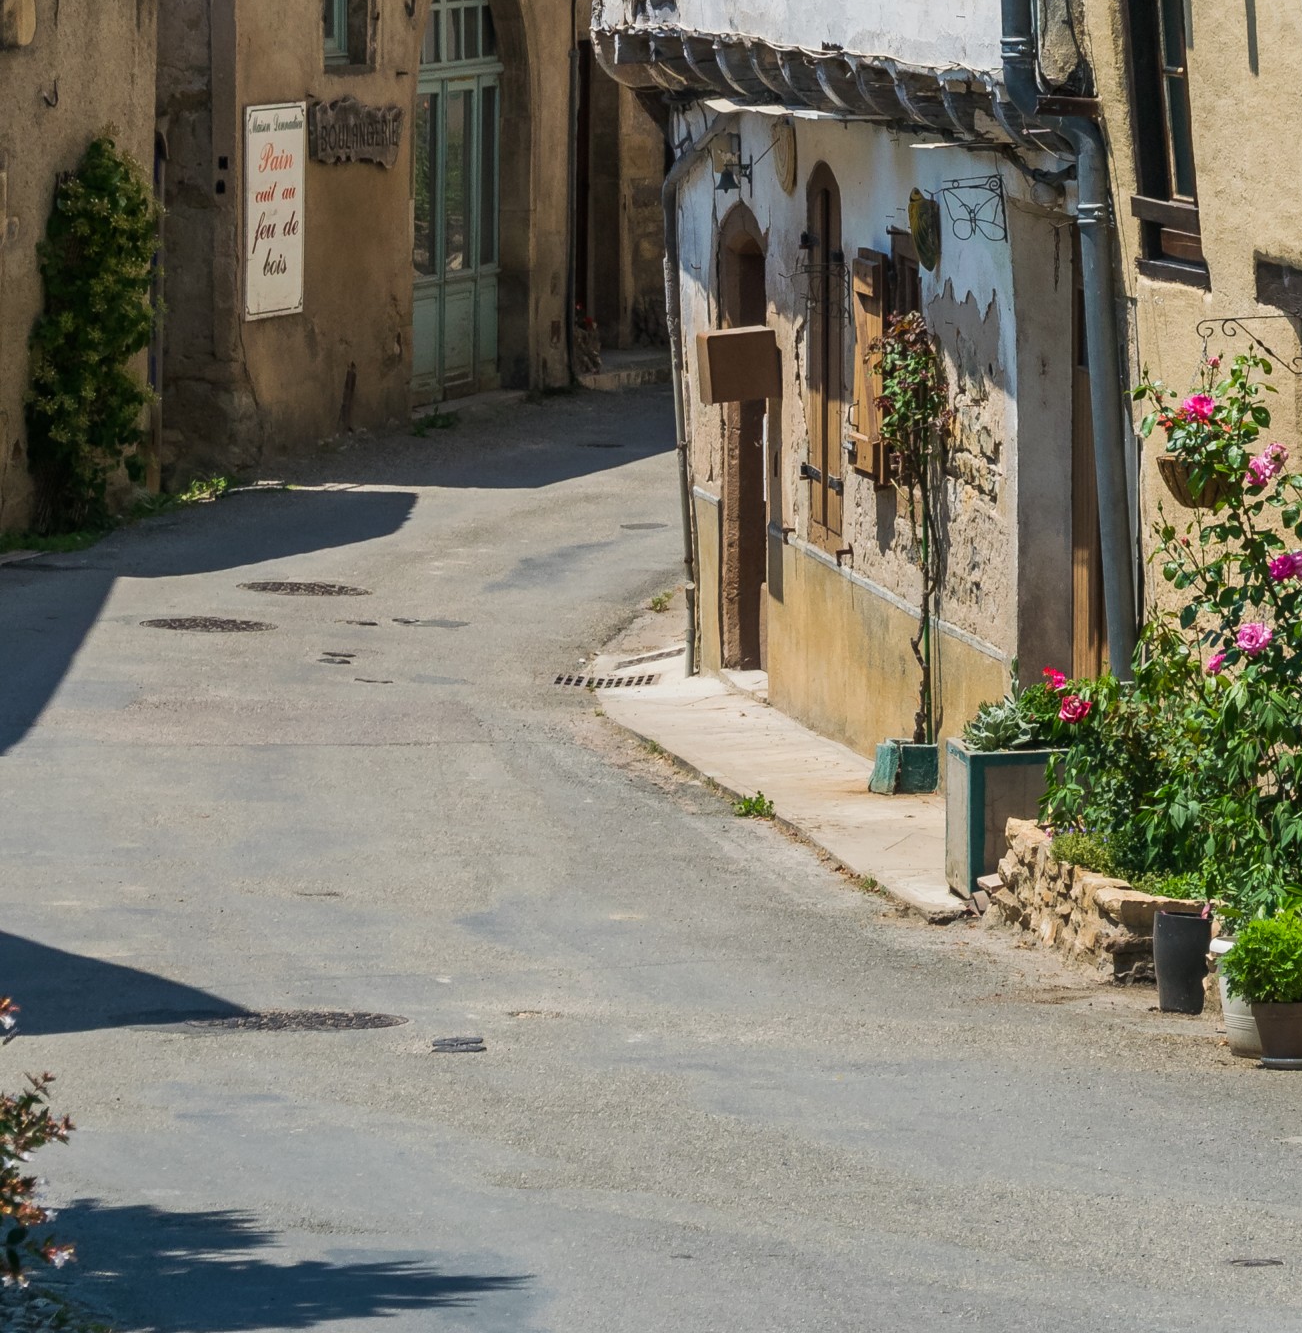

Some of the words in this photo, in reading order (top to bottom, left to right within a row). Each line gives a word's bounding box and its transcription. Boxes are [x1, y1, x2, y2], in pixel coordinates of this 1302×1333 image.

[320, 118, 400, 151] BOULANGERIE
[258, 142, 294, 173] Pain
[255, 181, 277, 203] cuit
[281, 187, 296, 201] au
[252, 211, 277, 254] feu
[283, 210, 300, 236] de
[262, 247, 287, 276] bois
